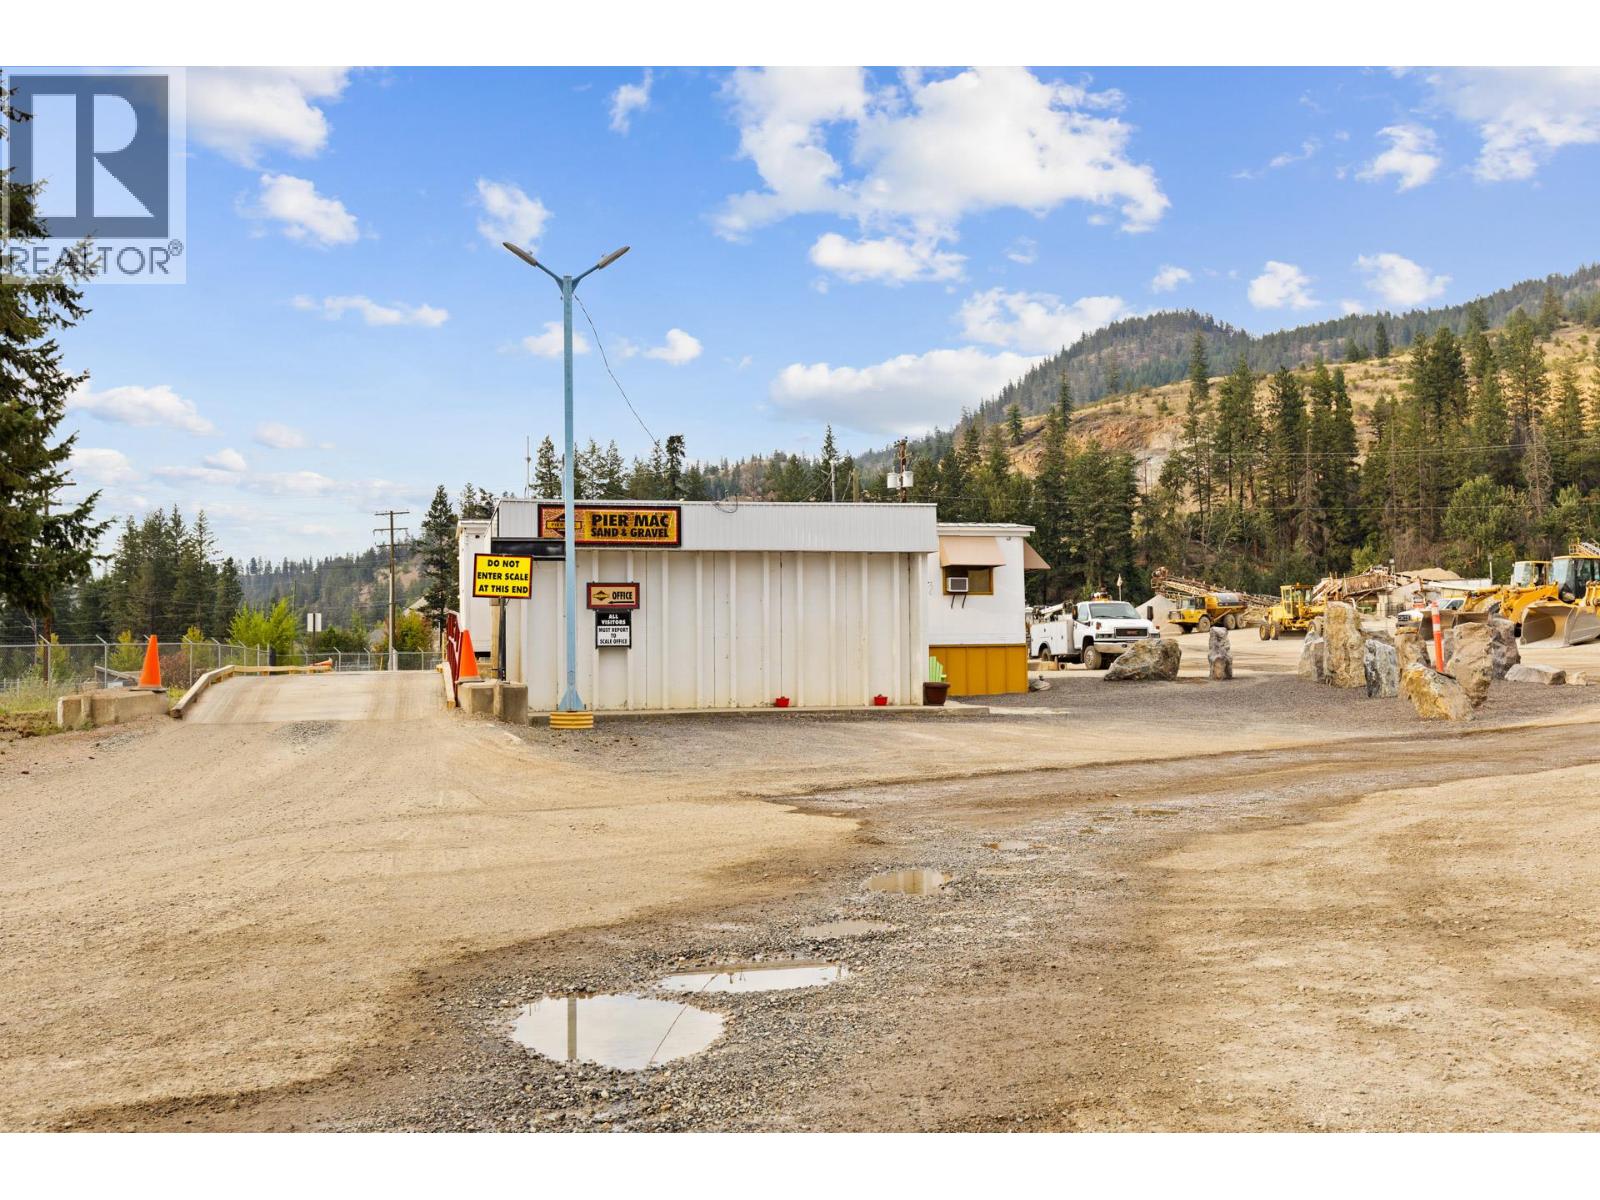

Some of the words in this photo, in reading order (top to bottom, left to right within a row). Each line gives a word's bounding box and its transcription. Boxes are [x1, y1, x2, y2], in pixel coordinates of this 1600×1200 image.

[591, 514, 629, 527] PIER
[634, 514, 669, 527] MAC
[591, 528, 619, 537] SAND
[621, 528, 627, 537] &
[630, 528, 669, 538] GRAVEL
[487, 559, 500, 567] DO
[502, 560, 520, 568] NOT
[477, 572, 502, 580] ENTER
[504, 572, 529, 581] SCALE
[478, 584, 489, 592] AT
[491, 585, 509, 593] THIS
[511, 585, 528, 594] END
[612, 591, 633, 600] OFFICE
